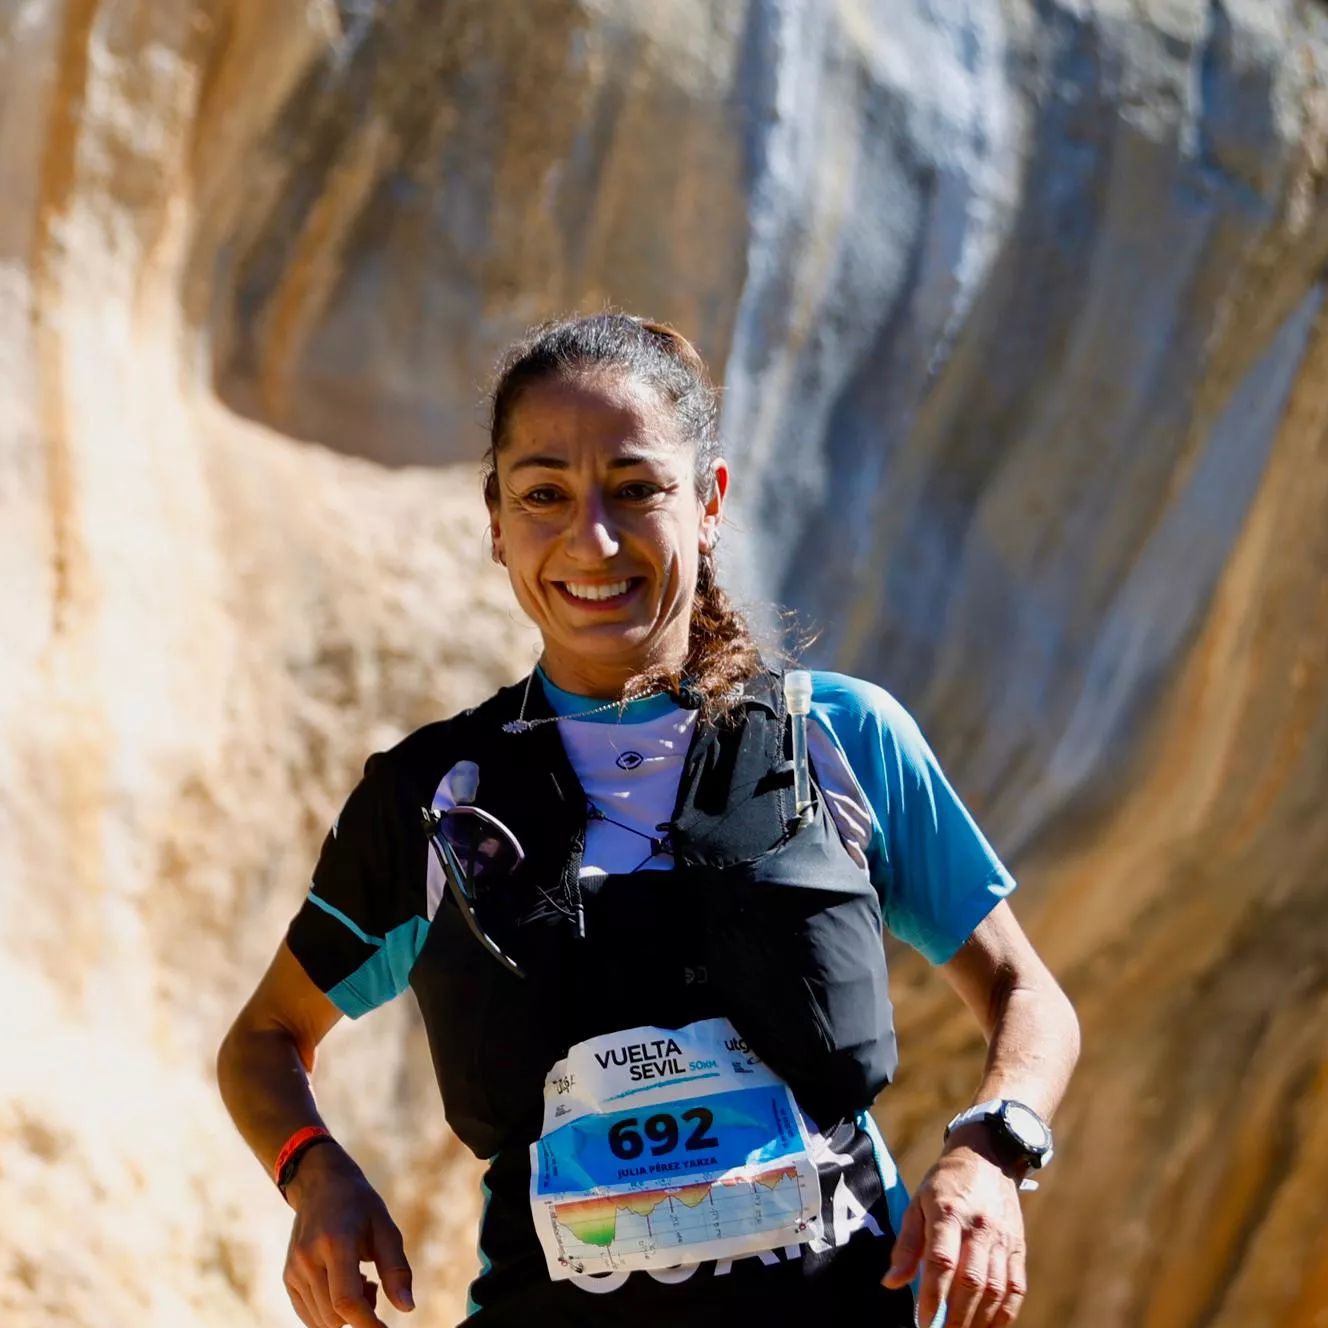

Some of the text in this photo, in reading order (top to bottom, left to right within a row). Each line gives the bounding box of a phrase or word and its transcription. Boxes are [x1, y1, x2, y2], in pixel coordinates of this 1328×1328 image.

[595, 1038, 682, 1069] VUELTA
[629, 1058, 686, 1081] SEVIL
[609, 1107, 719, 1160] 692
[617, 1167, 646, 1180] JULIA
